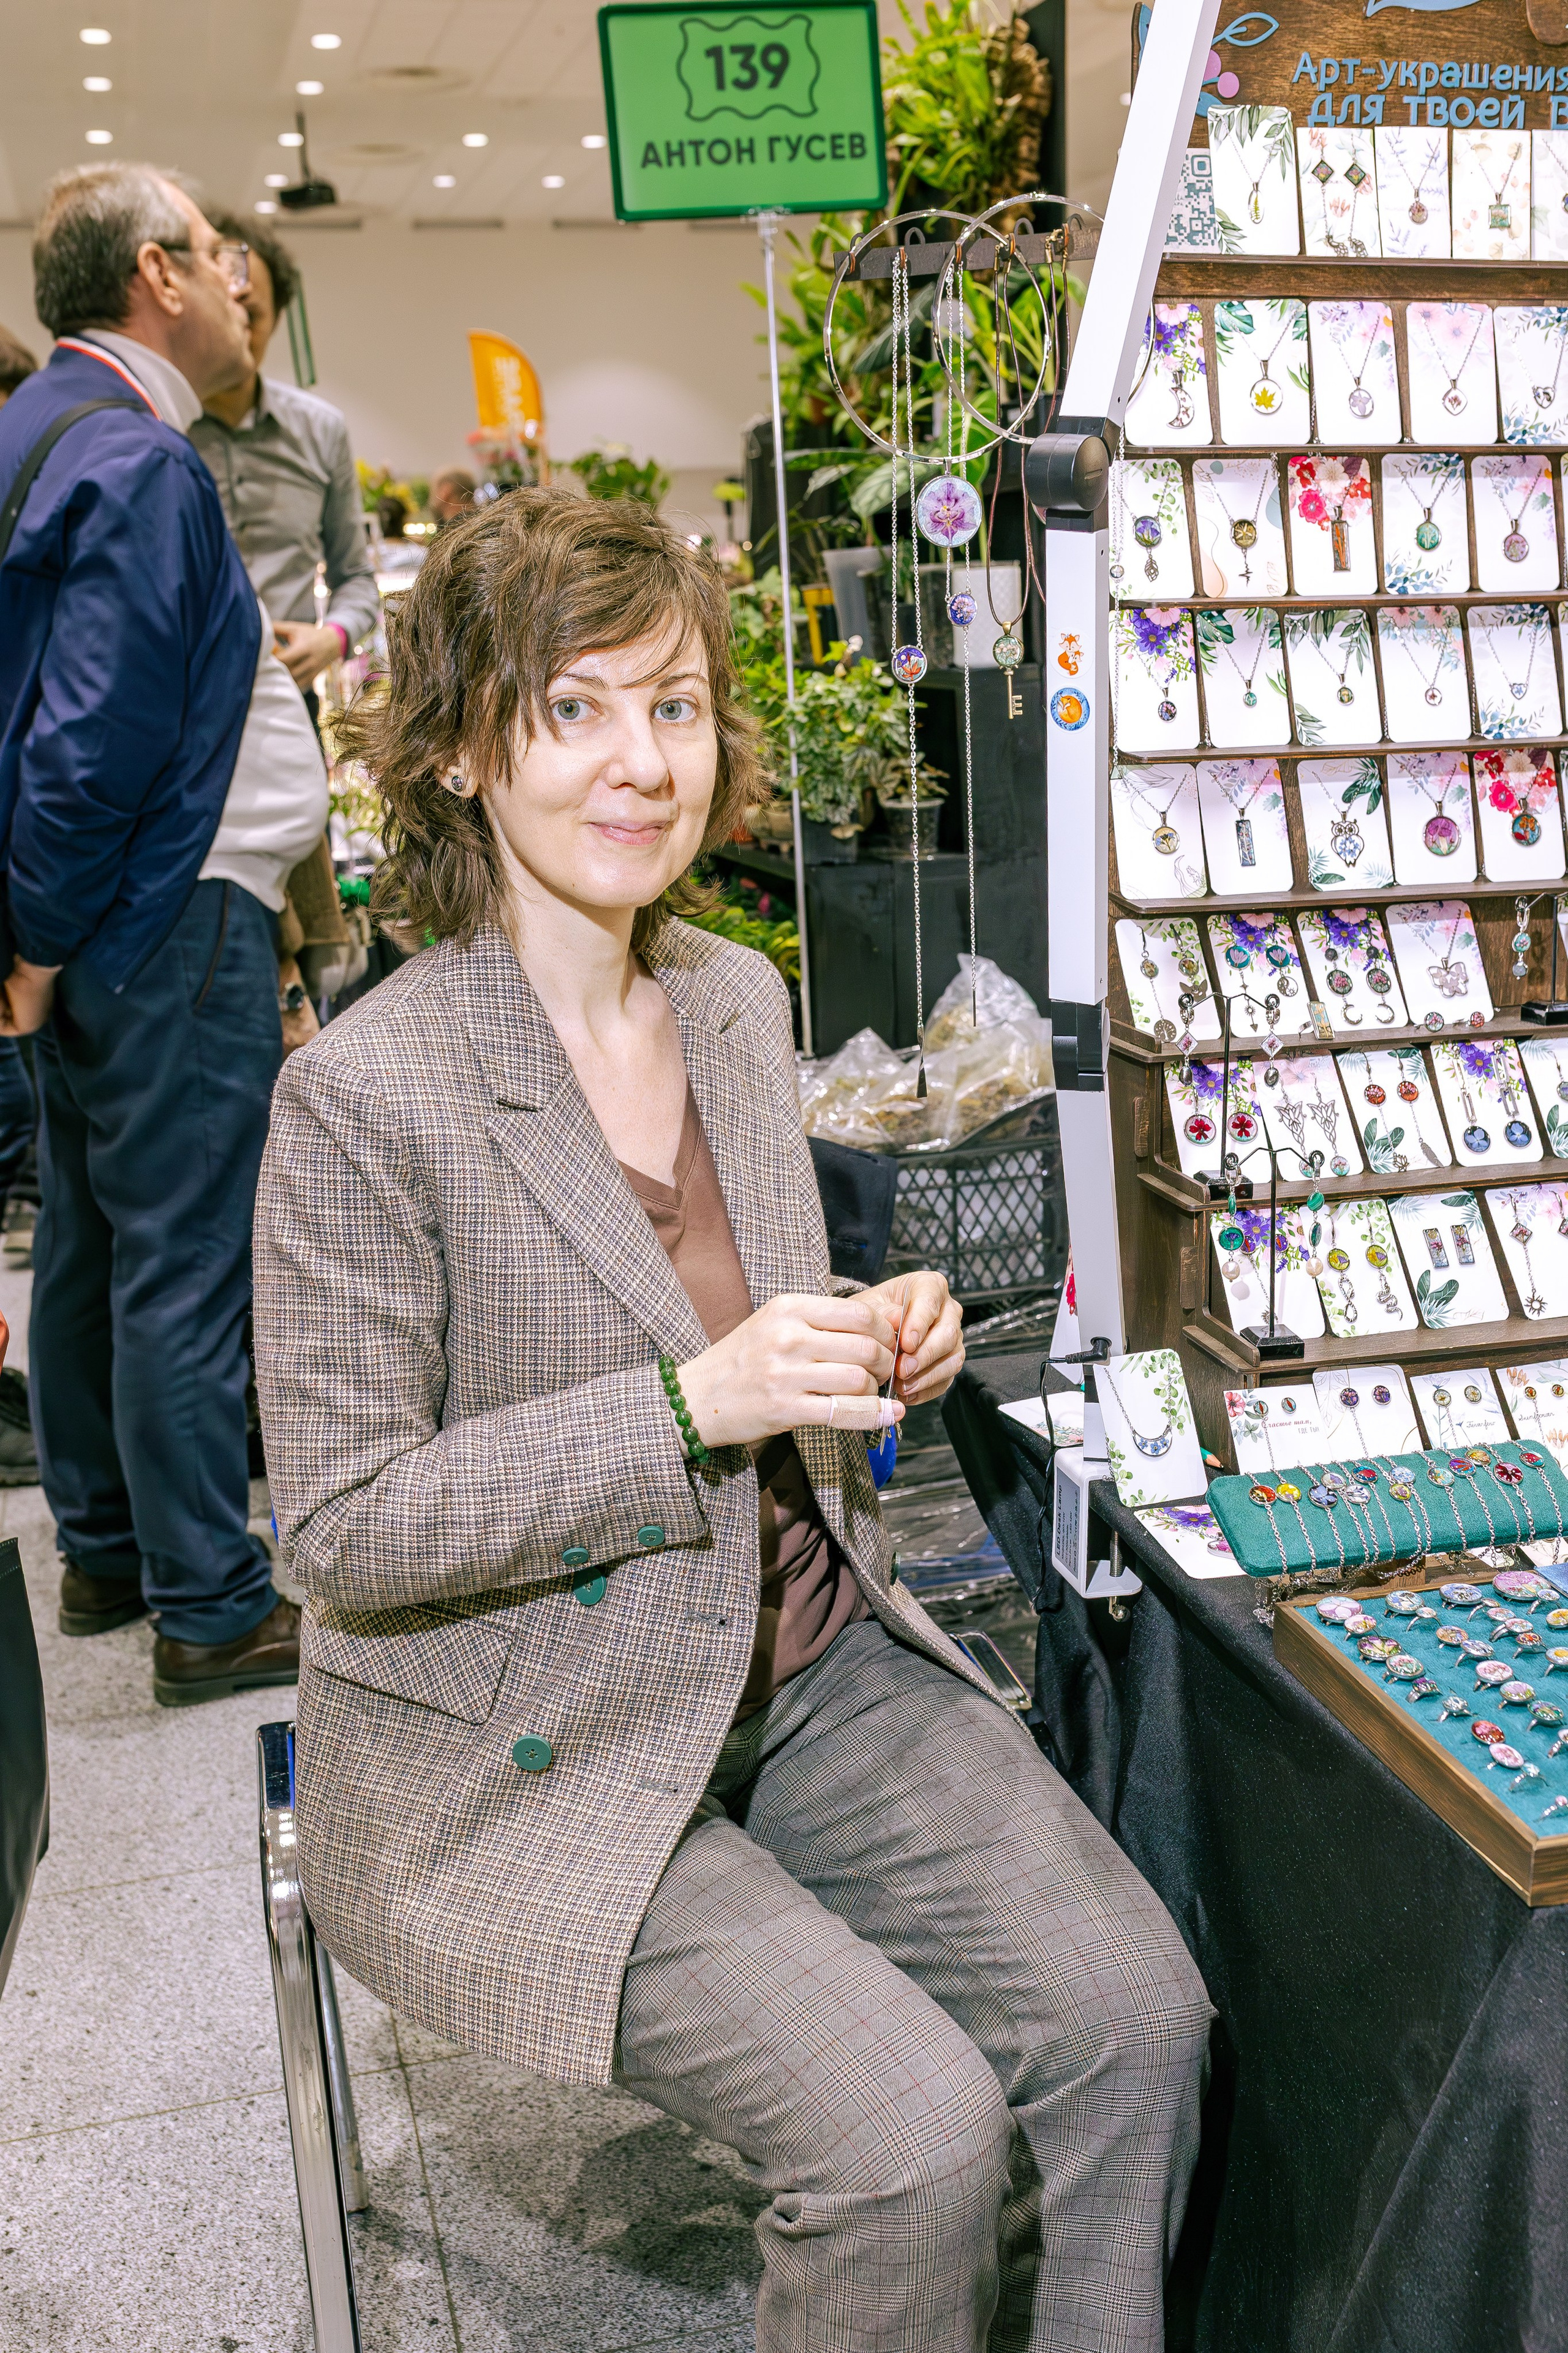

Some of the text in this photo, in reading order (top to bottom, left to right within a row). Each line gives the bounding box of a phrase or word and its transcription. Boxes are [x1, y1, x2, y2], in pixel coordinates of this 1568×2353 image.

[704, 42, 790, 91] 139
[1292, 51, 1568, 95] Арт-украшения
[1403, 94, 1526, 129] твоей
[641, 132, 867, 169] АНТОН ГУСЕВ
